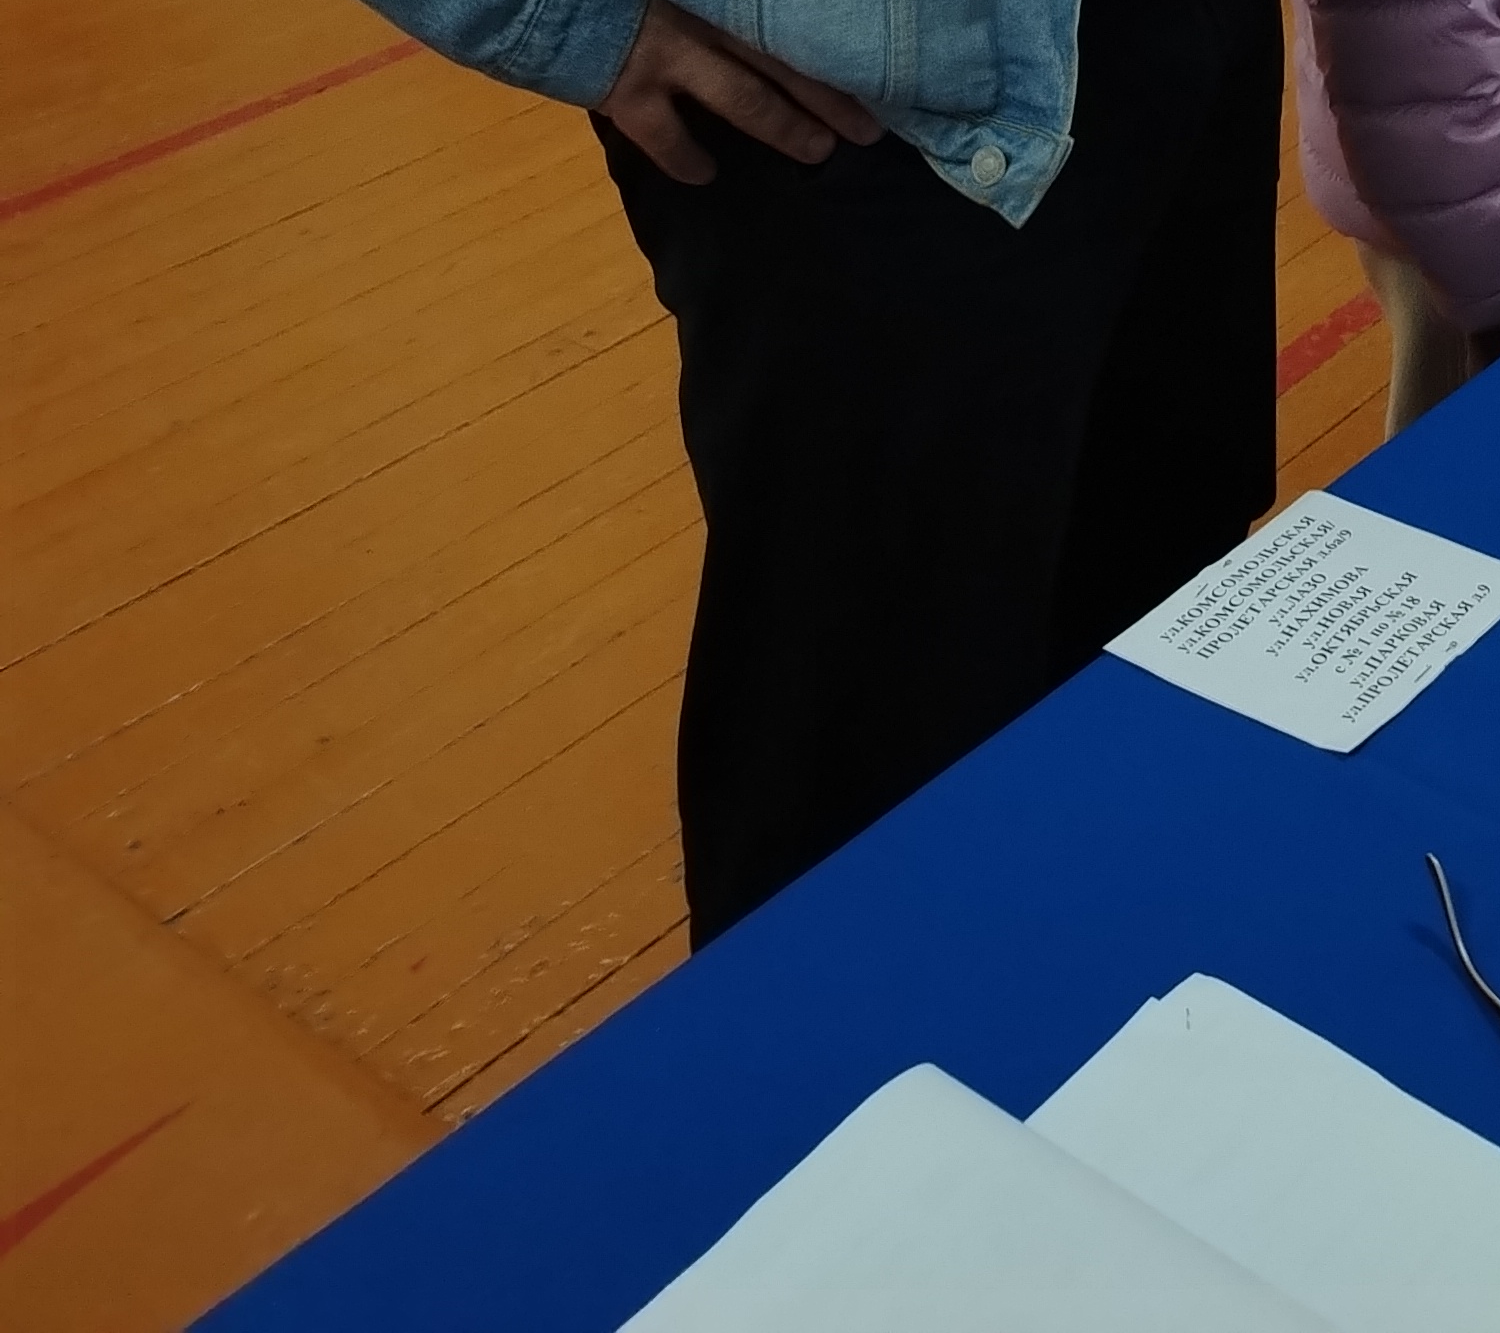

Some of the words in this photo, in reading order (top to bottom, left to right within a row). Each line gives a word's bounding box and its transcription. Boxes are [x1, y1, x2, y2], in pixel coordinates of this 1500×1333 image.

[1159, 515, 1317, 644] ул.КОМСОМОЛЬСКАЯ
[1177, 520, 1335, 654] ул.КОМСОМОЛЬСКАЯ/
[1196, 557, 1318, 660] ПРОЛЕТАРСКАЯ
[1316, 529, 1353, 560] д.6а/9
[1265, 564, 1370, 657] ул.НАХИМОВА
[1268, 572, 1328, 627] ул.ЛАЗО
[1294, 570, 1419, 683] ул.ОКТЯБРЬСКАЯ
[1302, 585, 1374, 650] ул.НОВАЯ
[1335, 665, 1347, 675] с
[1342, 647, 1364, 666] №
[1357, 636, 1372, 647] 1
[1370, 622, 1390, 639] по
[1385, 609, 1406, 624] №
[1401, 594, 1422, 612] 18
[1342, 599, 1475, 724] ул.ПРОЛЕТАРСКАЯ
[1474, 583, 1492, 604] д.9
[1350, 599, 1447, 689] ул.ПАРКОВАЯ
